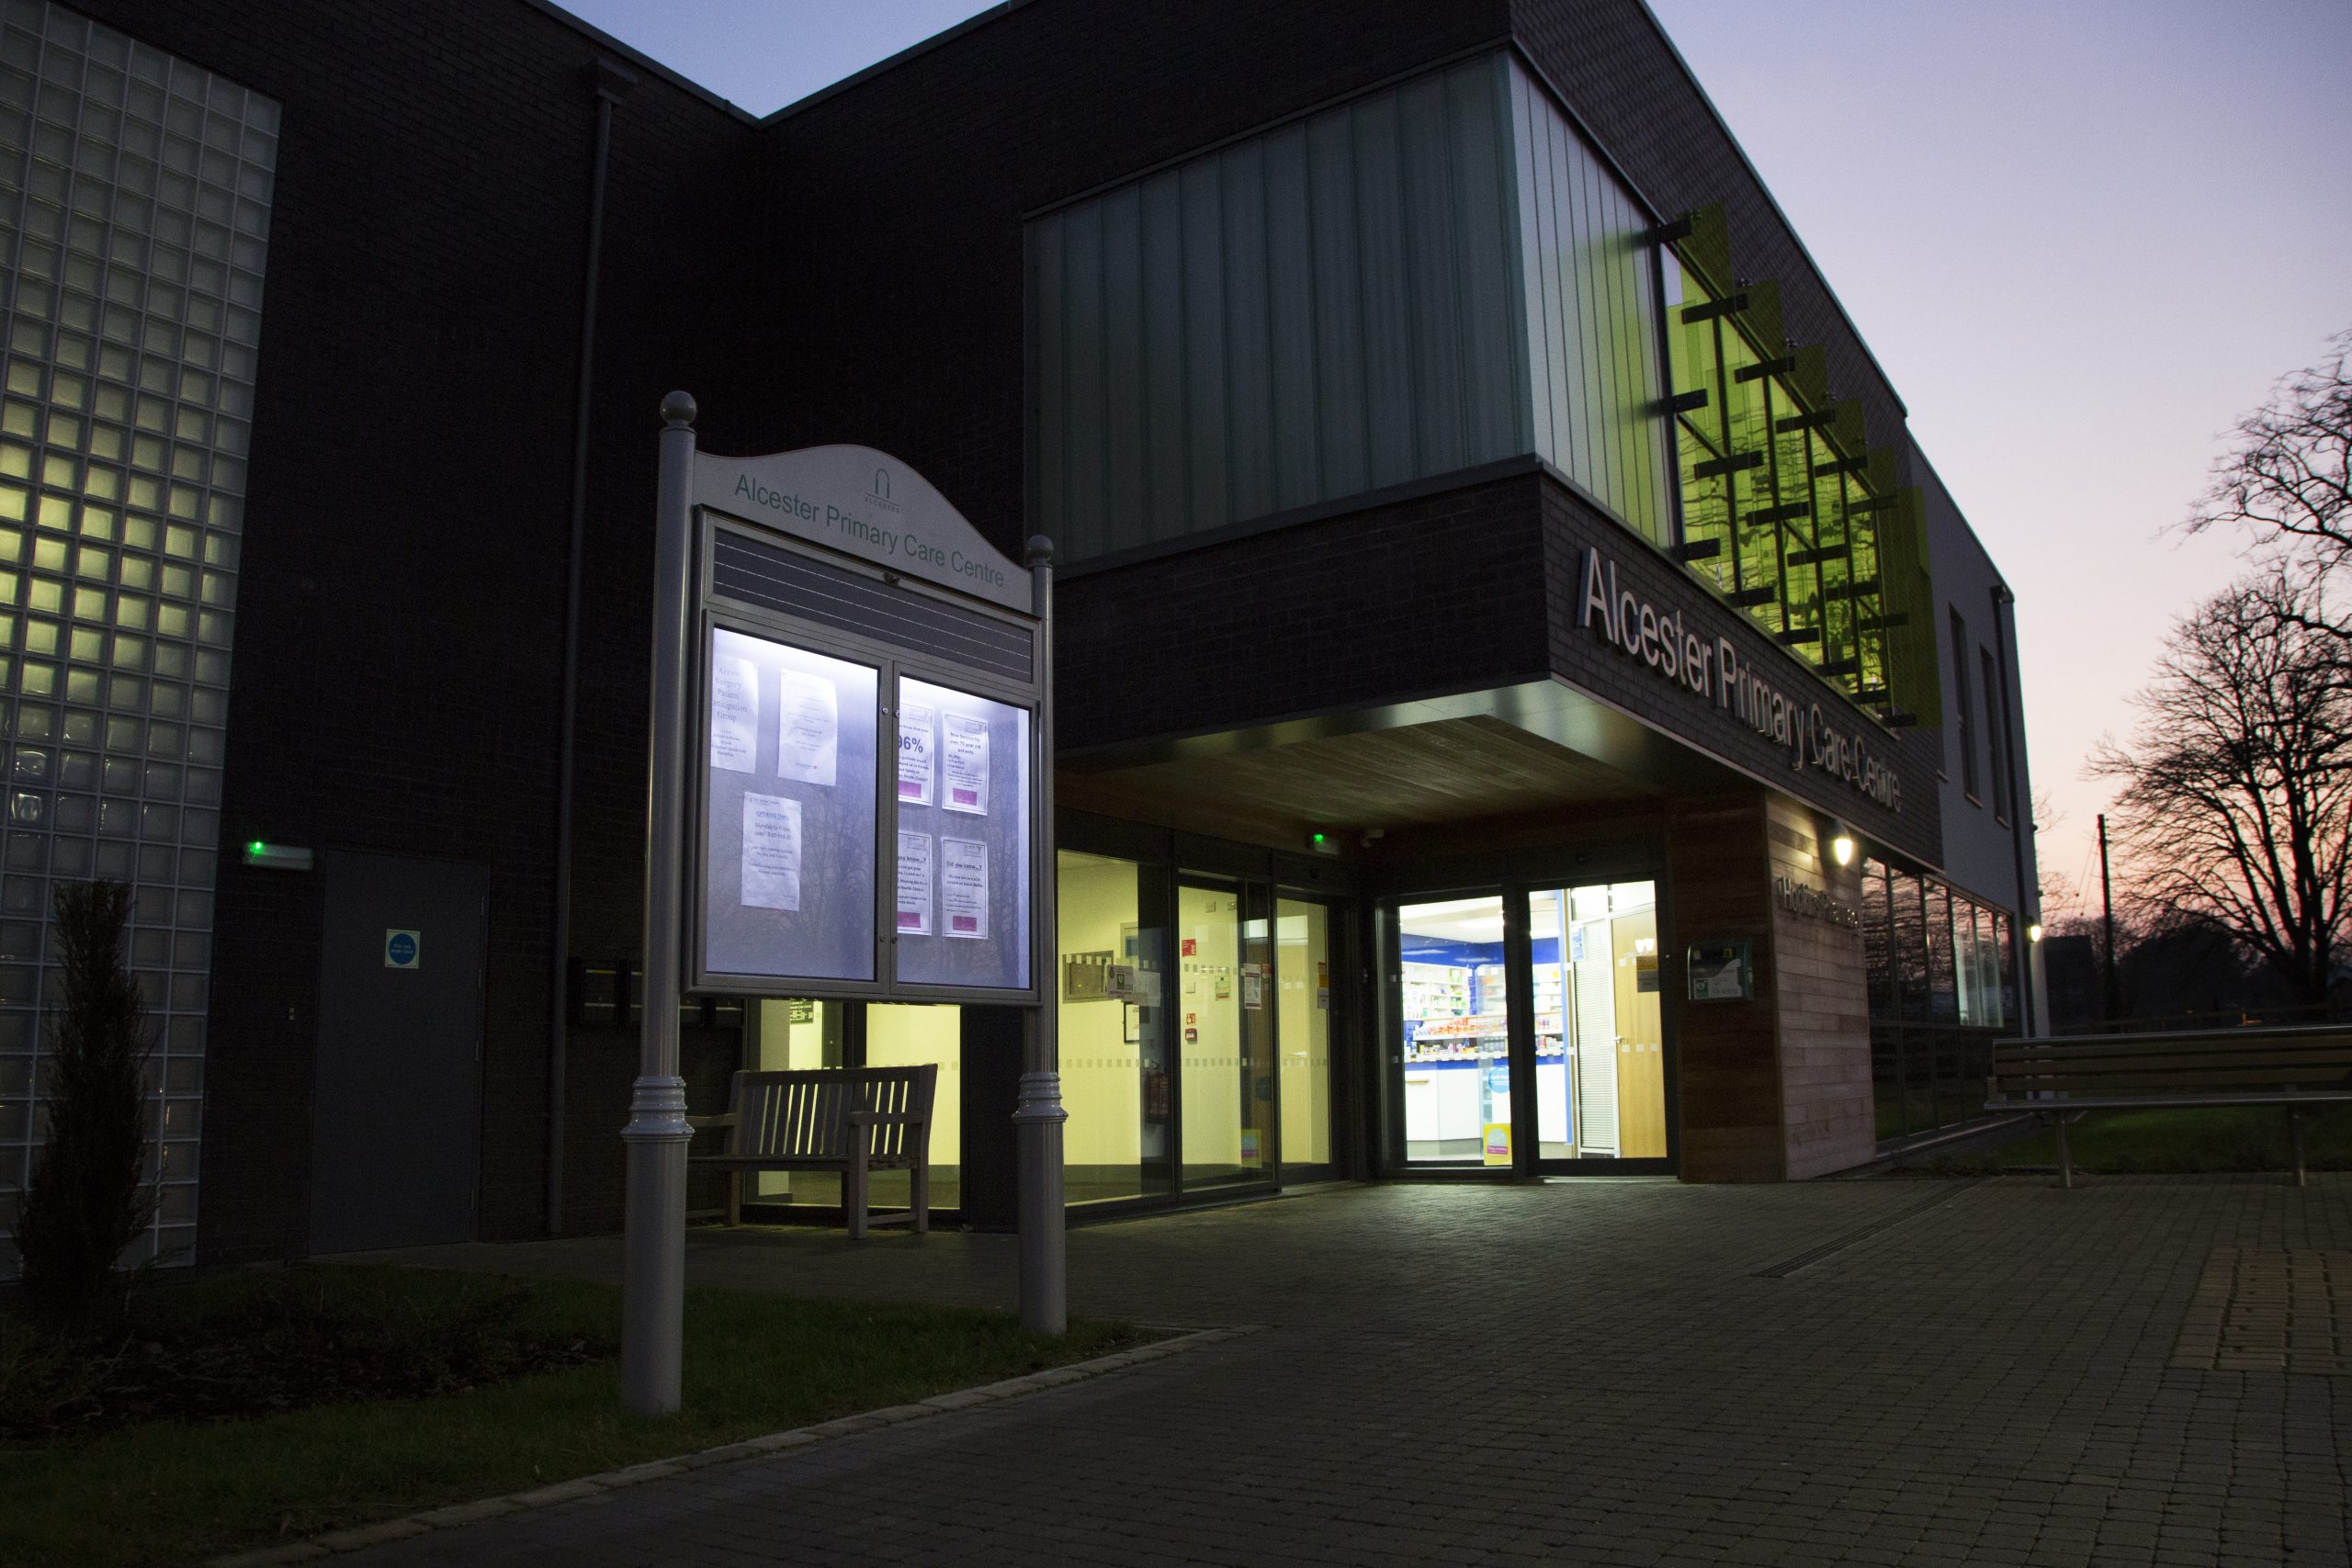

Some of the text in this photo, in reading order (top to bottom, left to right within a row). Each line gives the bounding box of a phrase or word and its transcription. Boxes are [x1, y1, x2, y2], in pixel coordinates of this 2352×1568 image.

[734, 473, 1005, 588] Alcester Primary Care Centre
[717, 710, 738, 724] Group
[1577, 547, 1903, 813] Alcester Primary Care Centre
